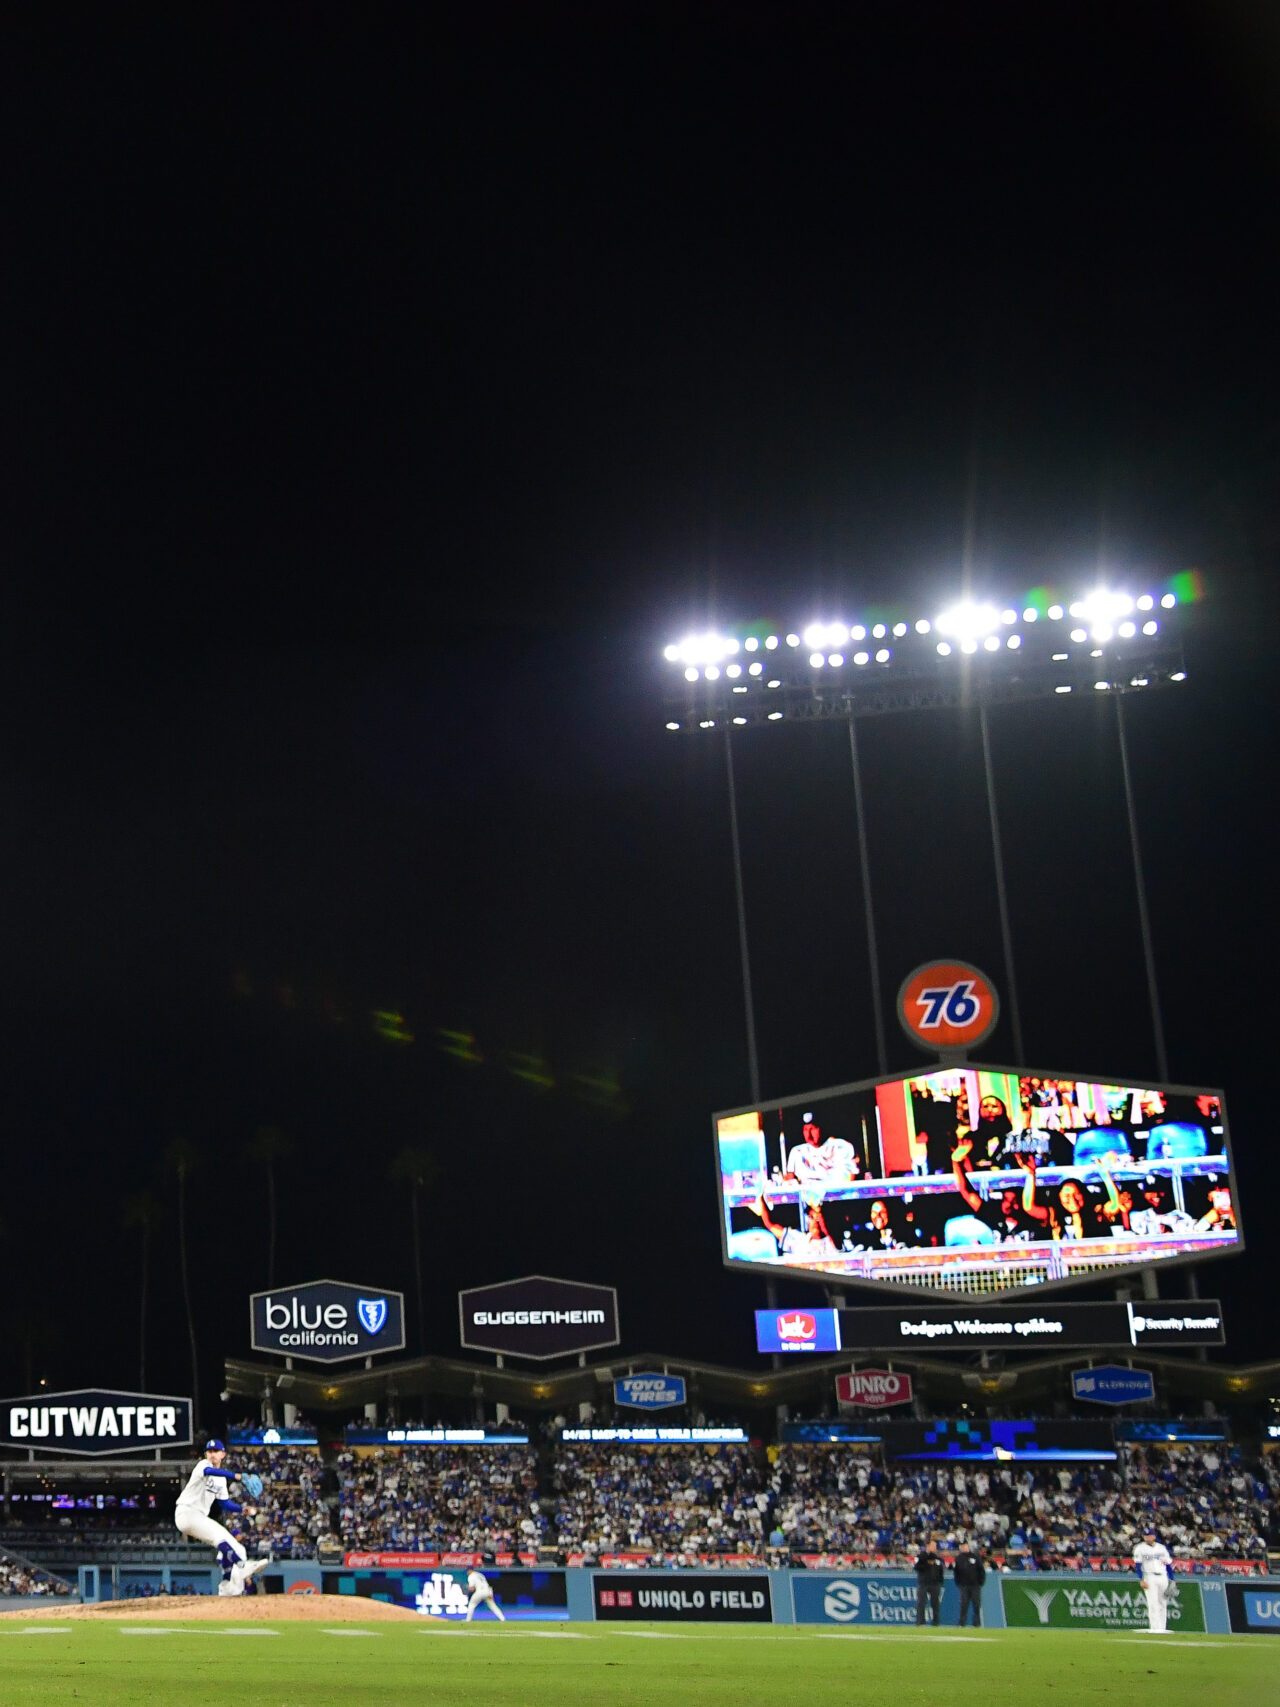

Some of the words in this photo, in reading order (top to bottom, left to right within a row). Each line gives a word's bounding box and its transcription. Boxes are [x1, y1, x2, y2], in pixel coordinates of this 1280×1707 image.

[916, 980, 980, 1029] 76
[266, 1297, 348, 1329] blue
[473, 1310, 605, 1325] GUGGENHEIM
[900, 1321, 953, 1337] Dodgers
[953, 1320, 1012, 1334] Welcome
[1145, 1318, 1183, 1331] Security
[279, 1331, 358, 1345] california
[623, 1380, 665, 1392] TOYO
[849, 1376, 900, 1399] JINRO
[630, 1390, 676, 1402] TIRES
[9, 1406, 177, 1438] CUTWATER
[638, 1590, 705, 1610] UNIQLO
[709, 1591, 765, 1608] FIELD
[1071, 1607, 1120, 1618] RESORT
[1122, 1608, 1131, 1618] &
